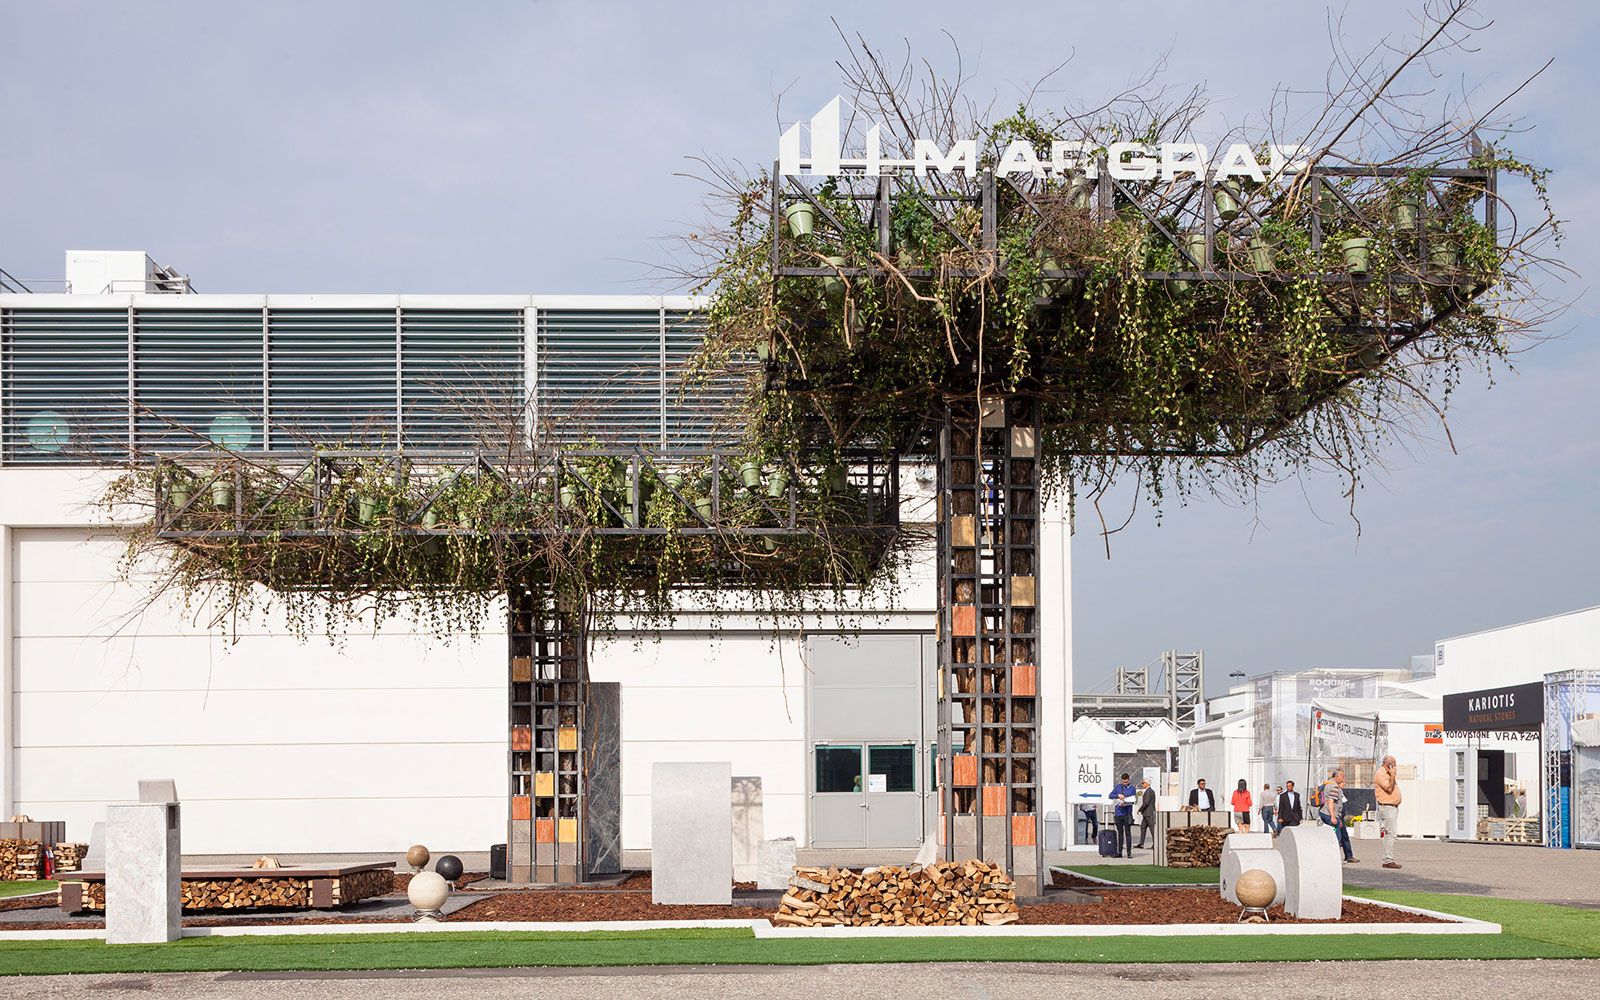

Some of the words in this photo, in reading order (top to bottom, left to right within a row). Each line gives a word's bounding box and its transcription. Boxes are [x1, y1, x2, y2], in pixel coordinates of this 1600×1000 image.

[914, 138, 1310, 183] MARGRAF
[1468, 693, 1515, 711] KARIOTIS
[1469, 713, 1493, 723] NATURAL
[1494, 710, 1516, 721] STONES
[1079, 763, 1101, 774] ALL
[1078, 775, 1102, 784] FOOD
